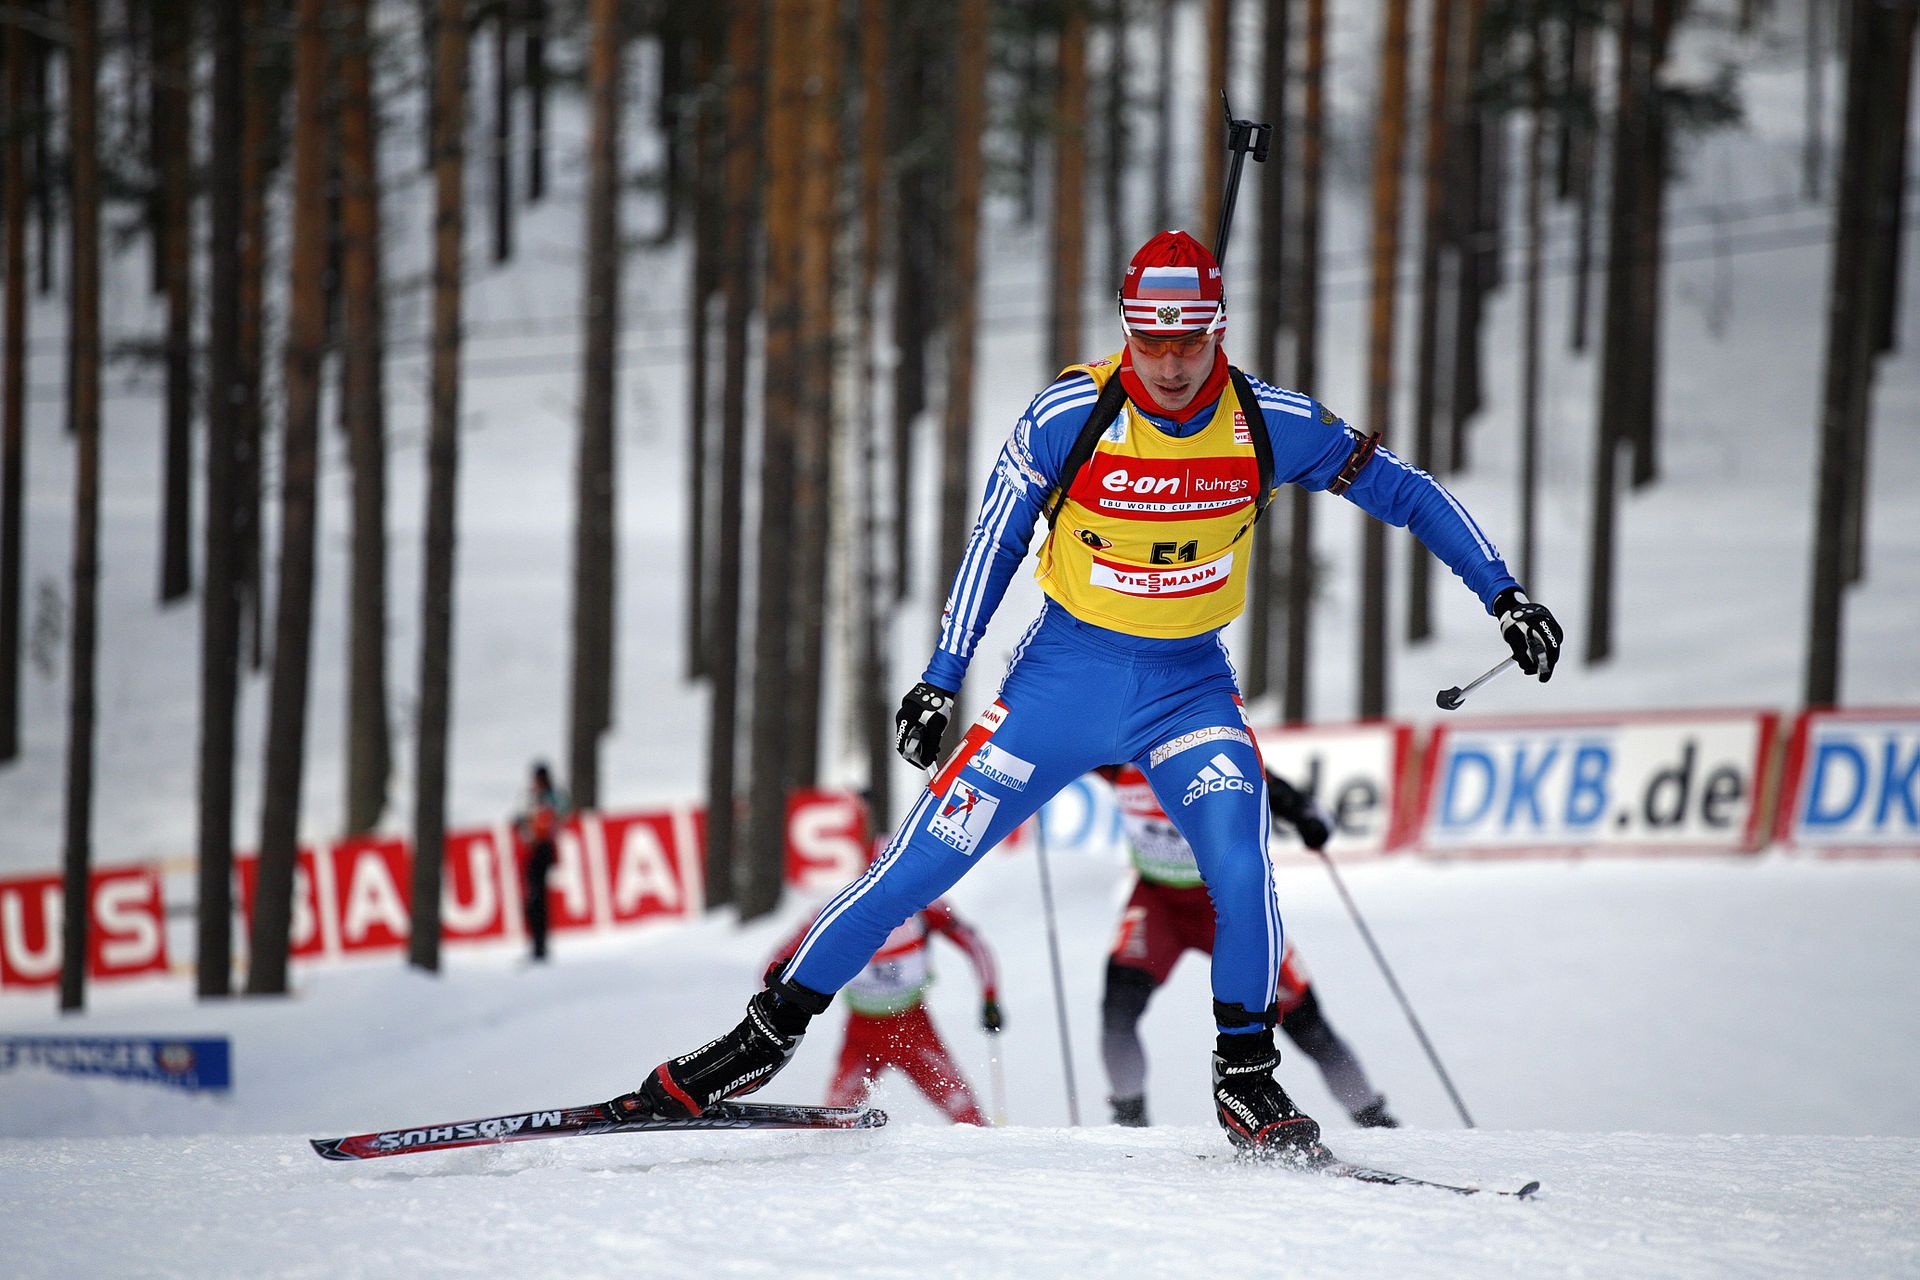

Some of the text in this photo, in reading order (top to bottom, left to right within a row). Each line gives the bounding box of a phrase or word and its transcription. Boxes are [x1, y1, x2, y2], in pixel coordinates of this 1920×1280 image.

[1103, 500, 1121, 508] IBU
[1127, 502, 1166, 511] WORLD
[1150, 540, 1198, 564] 51
[1539, 619, 1558, 649] adidas
[983, 765, 1027, 790] GAZPROM
[1182, 776, 1254, 806] adidas
[1440, 739, 1746, 834] DKB.de
[931, 826, 969, 852] RBU
[748, 1005, 784, 1046] MADSHUS
[1225, 1058, 1277, 1075] MADSHUS
[707, 1063, 774, 1105] MADSHUS
[1217, 1088, 1260, 1130] MADSHUS
[378, 1110, 562, 1150] MADSHUS
